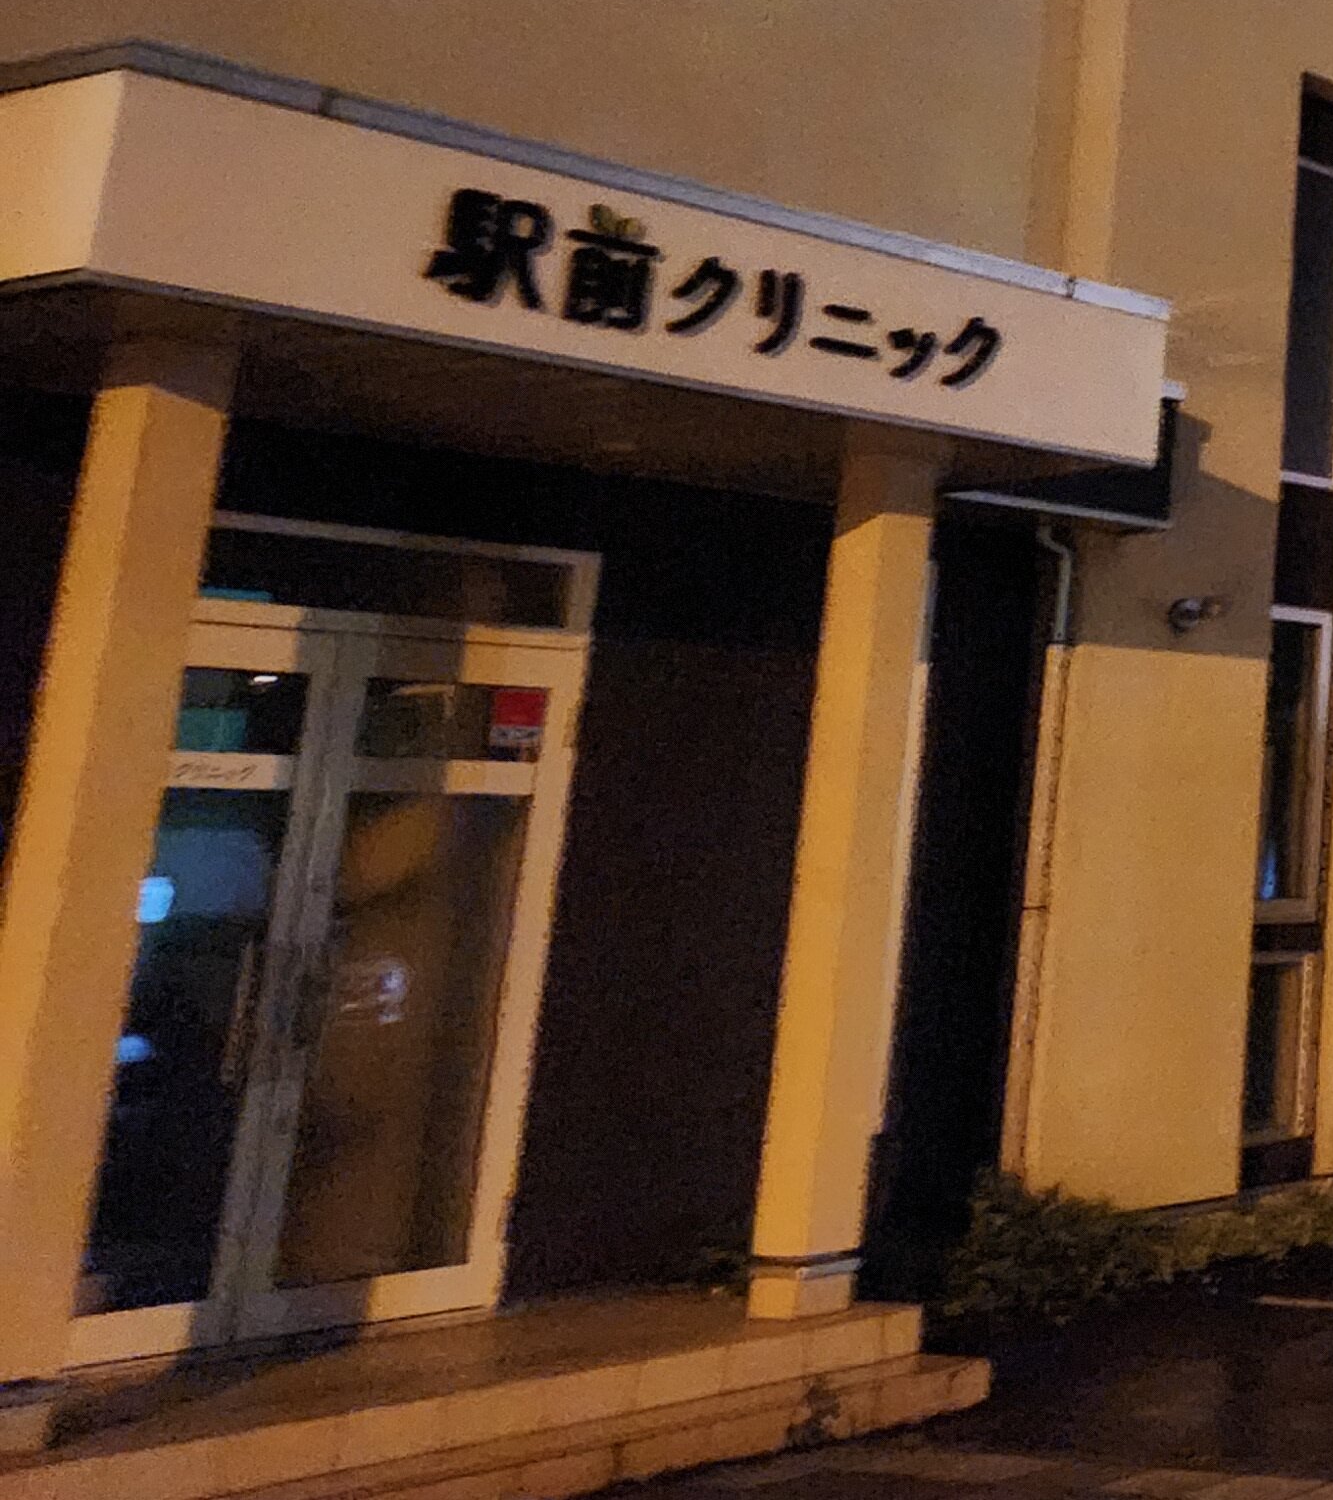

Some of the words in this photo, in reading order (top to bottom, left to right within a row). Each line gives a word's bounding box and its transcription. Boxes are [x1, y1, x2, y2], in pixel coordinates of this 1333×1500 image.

[423, 187, 1000, 386] 駅前クリニック
